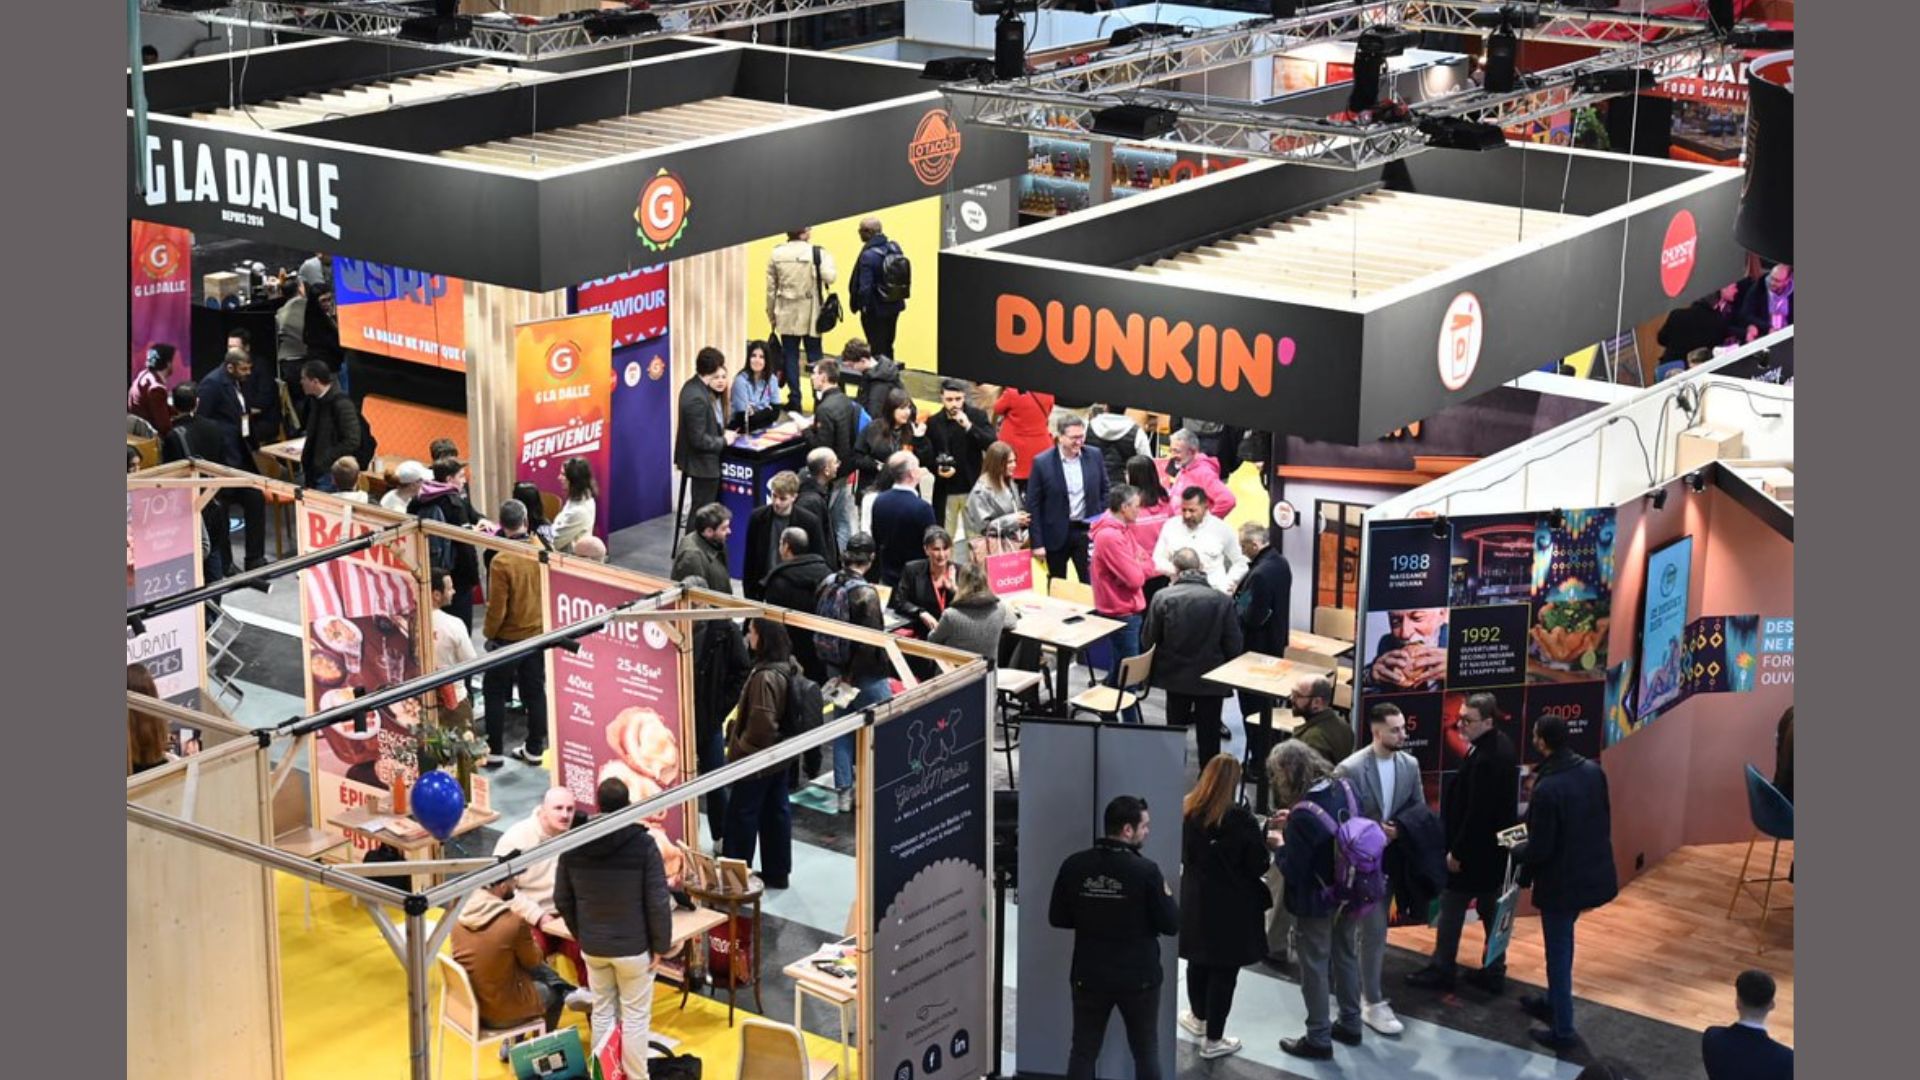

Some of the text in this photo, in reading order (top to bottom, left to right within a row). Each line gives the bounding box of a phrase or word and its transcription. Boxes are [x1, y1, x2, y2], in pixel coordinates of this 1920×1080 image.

[1663, 81, 1696, 96] FOOD
[172, 139, 219, 202] LA
[225, 147, 341, 240] DALLE
[649, 186, 674, 229] G
[221, 209, 265, 228] DEPUIS 2014
[150, 244, 168, 267] G
[363, 326, 375, 340] LA
[375, 329, 404, 347] DALLE
[404, 336, 418, 350] NE
[418, 339, 439, 355] FAIT
[440, 345, 461, 361] QUE
[996, 294, 1296, 397] DUNKIN'
[551, 348, 572, 372] G
[522, 419, 603, 464] BIENVENUE
[1390, 554, 1430, 571] 1988
[1461, 626, 1501, 644] 1992
[1766, 621, 1793, 633] DES
[1763, 638, 1784, 651] NE
[1763, 654, 1794, 668] FOR
[1761, 672, 1794, 685] OUV
[571, 701, 592, 718] 7%
